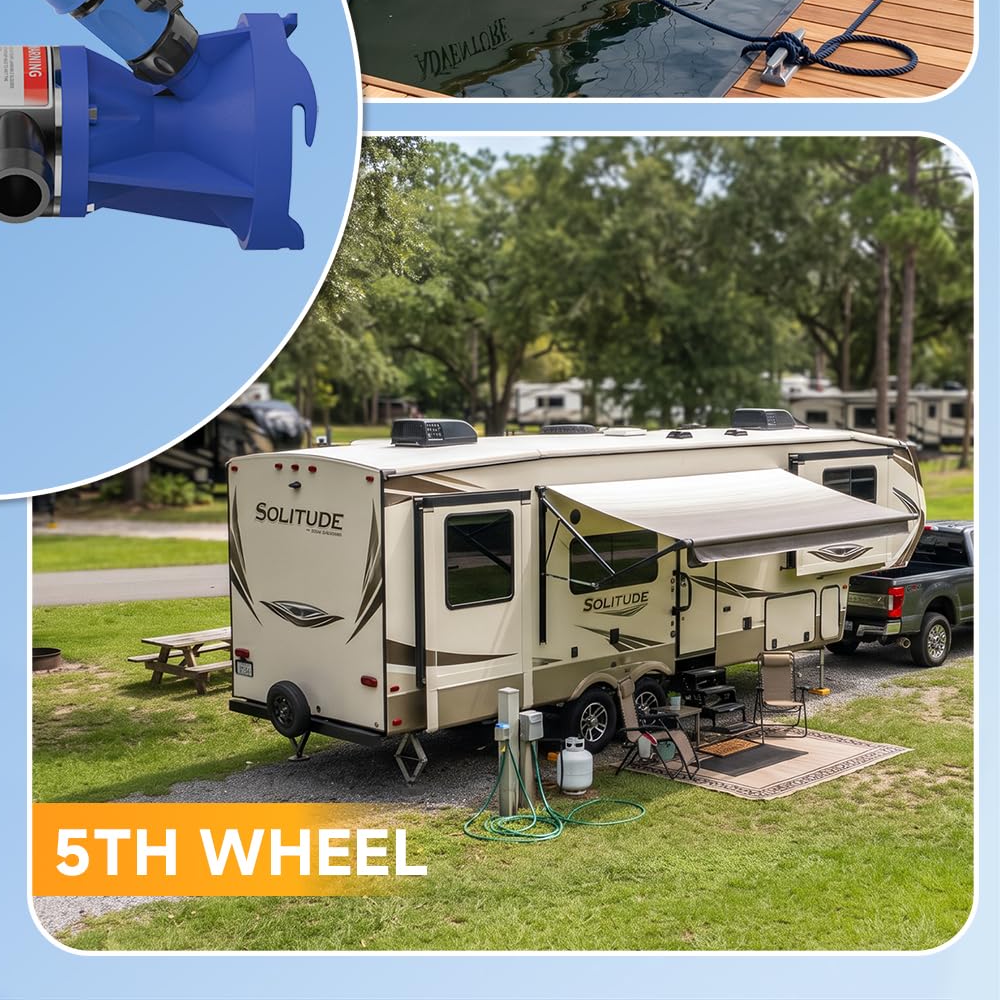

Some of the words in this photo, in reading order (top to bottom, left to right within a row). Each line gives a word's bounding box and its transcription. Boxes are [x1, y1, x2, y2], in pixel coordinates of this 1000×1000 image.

[27, 46, 43, 78] ARNING
[255, 502, 345, 530] SOLITUDE
[582, 591, 649, 612] SOLITUDE
